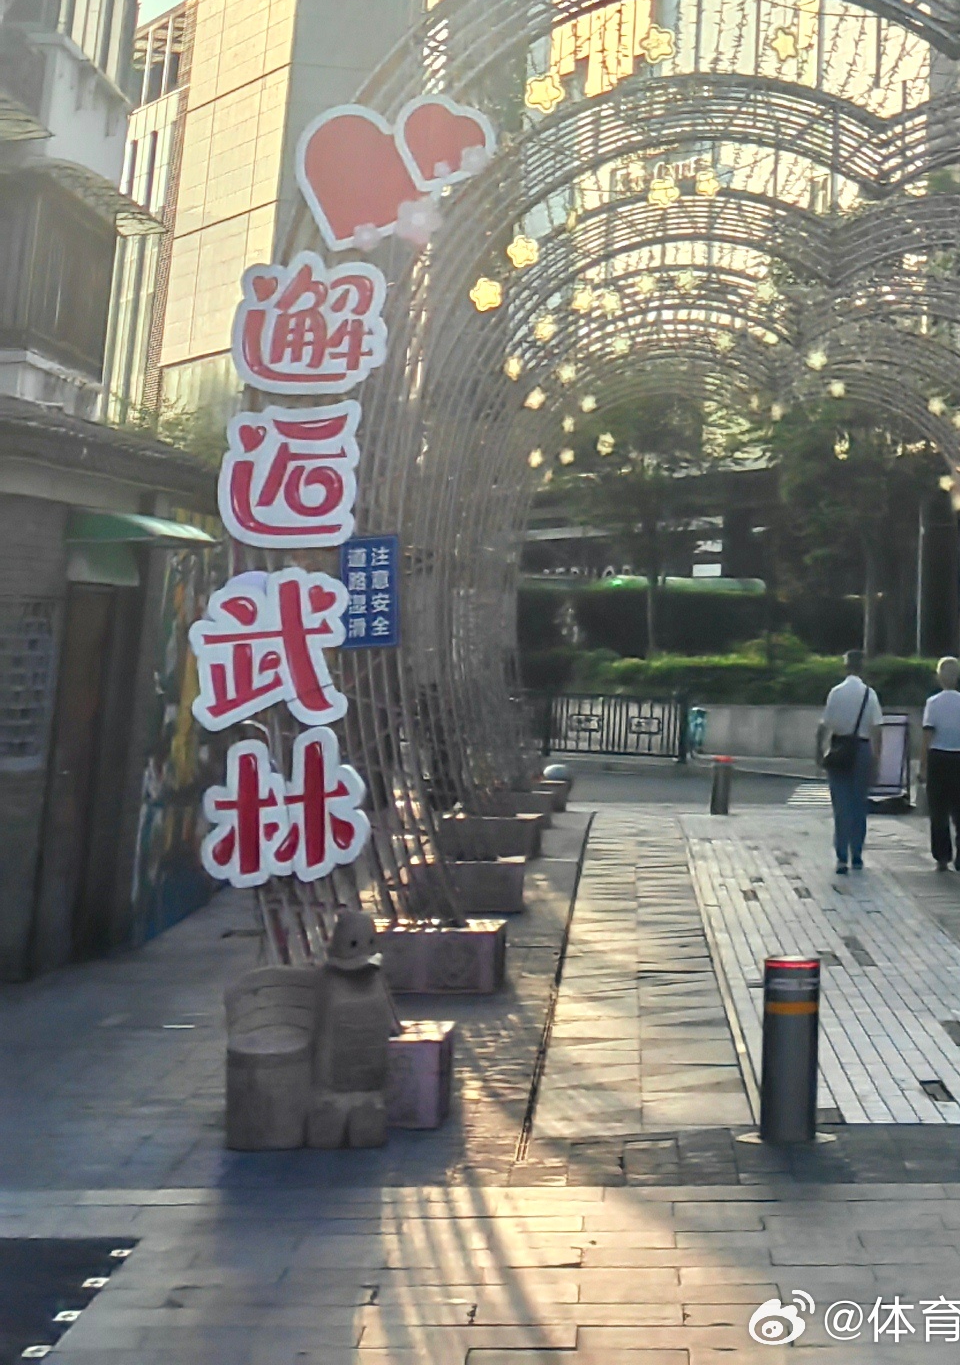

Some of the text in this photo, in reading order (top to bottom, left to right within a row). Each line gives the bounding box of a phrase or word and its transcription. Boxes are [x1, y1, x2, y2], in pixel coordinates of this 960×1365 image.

[203, 264, 374, 875] 邂逅武林
[371, 546, 390, 637] 注意安全
